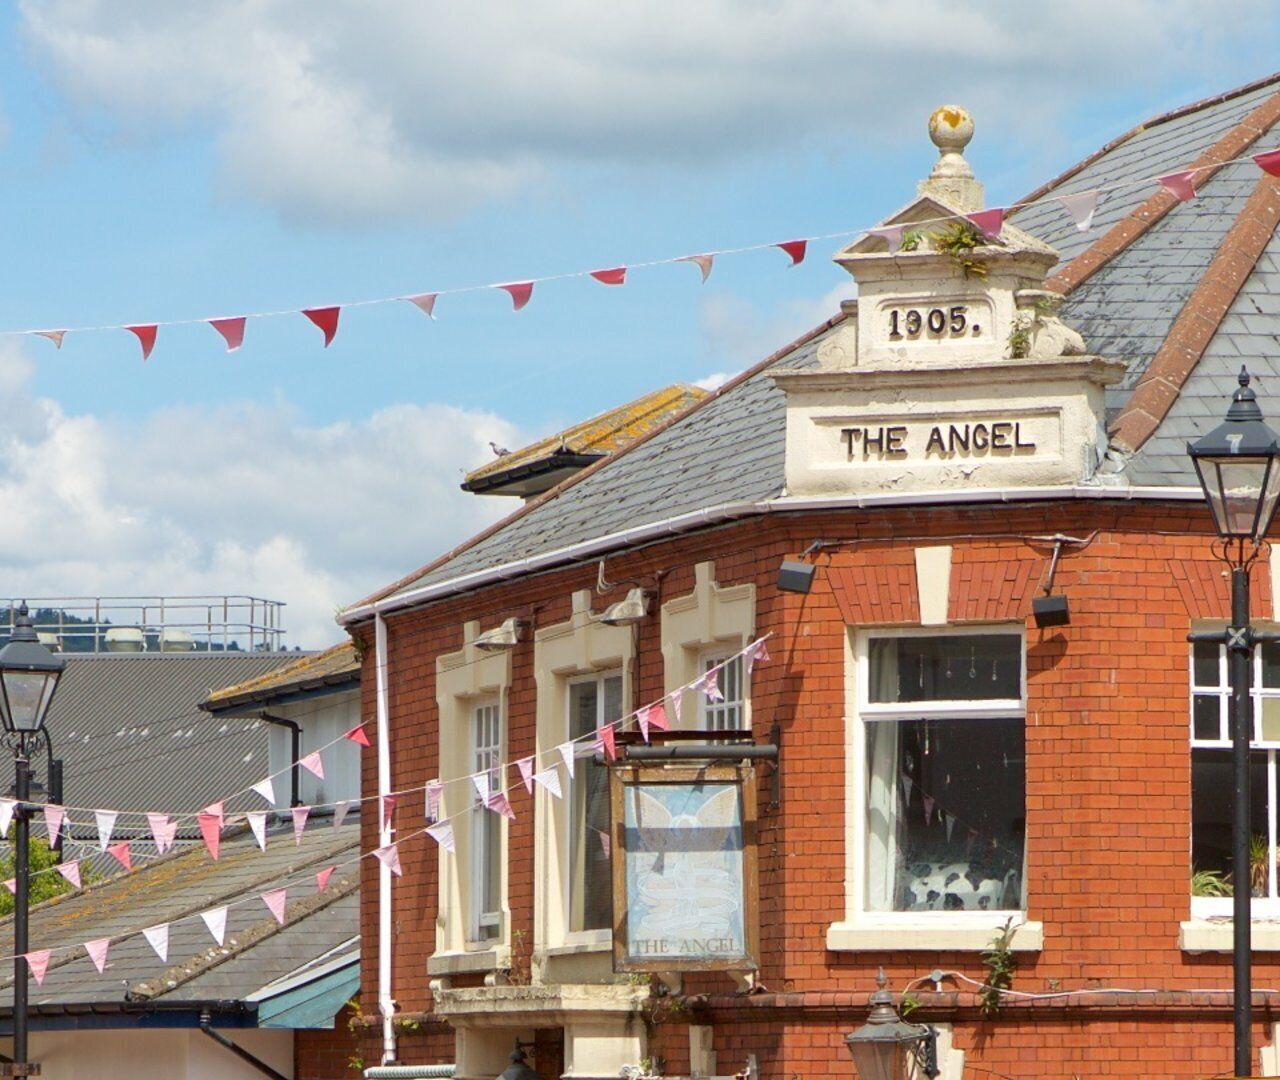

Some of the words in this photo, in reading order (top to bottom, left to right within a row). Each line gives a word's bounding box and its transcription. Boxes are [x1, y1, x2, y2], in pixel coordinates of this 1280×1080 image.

[888, 306, 981, 336] 1905.
[841, 426, 908, 455] THE
[925, 421, 1036, 452] ANGEL
[633, 938, 670, 954] THE
[679, 937, 739, 953] ANGEL
